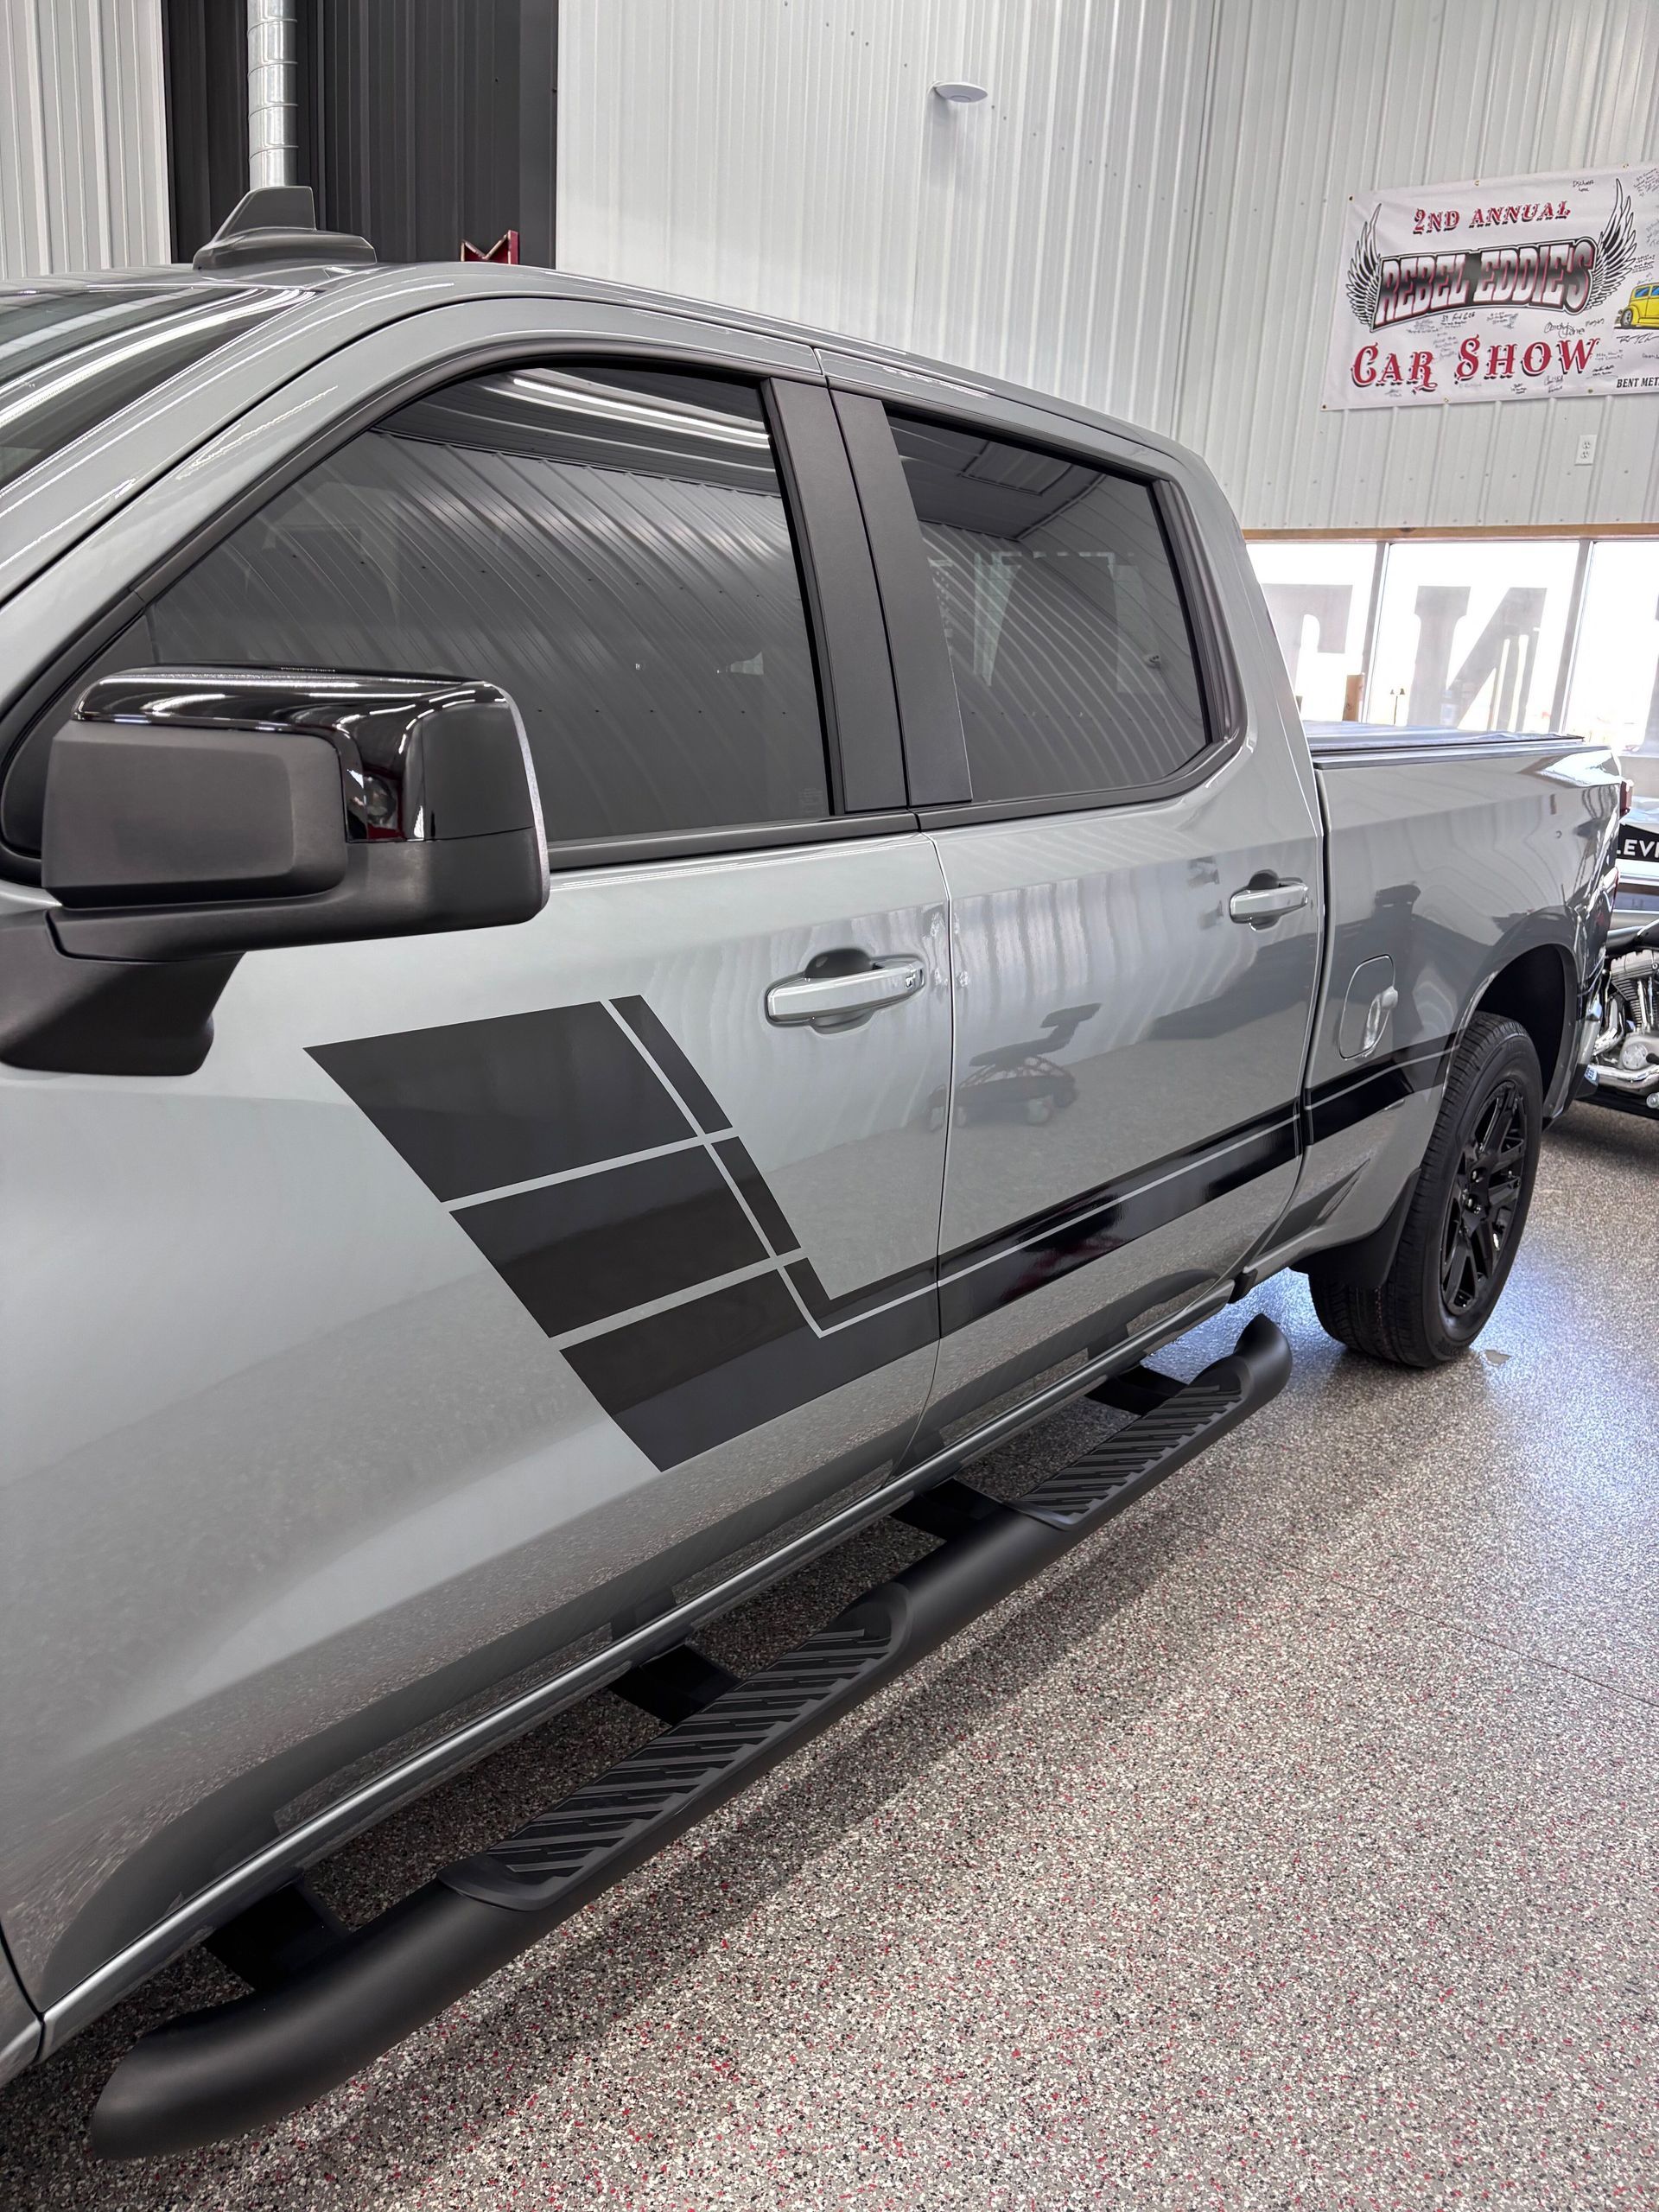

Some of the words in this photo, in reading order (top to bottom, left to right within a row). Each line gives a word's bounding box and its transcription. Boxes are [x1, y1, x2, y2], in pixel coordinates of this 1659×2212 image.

[1413, 208, 1460, 234] 2ND
[1469, 200, 1571, 228] ANNUAL
[1373, 253, 1469, 325] REBEL
[1473, 242, 1594, 310] EDDIE'S
[1351, 342, 1438, 395] CAR
[1454, 334, 1600, 385] SHOW
[1617, 378, 1640, 388] BENT
[1641, 376, 1659, 387] MET
